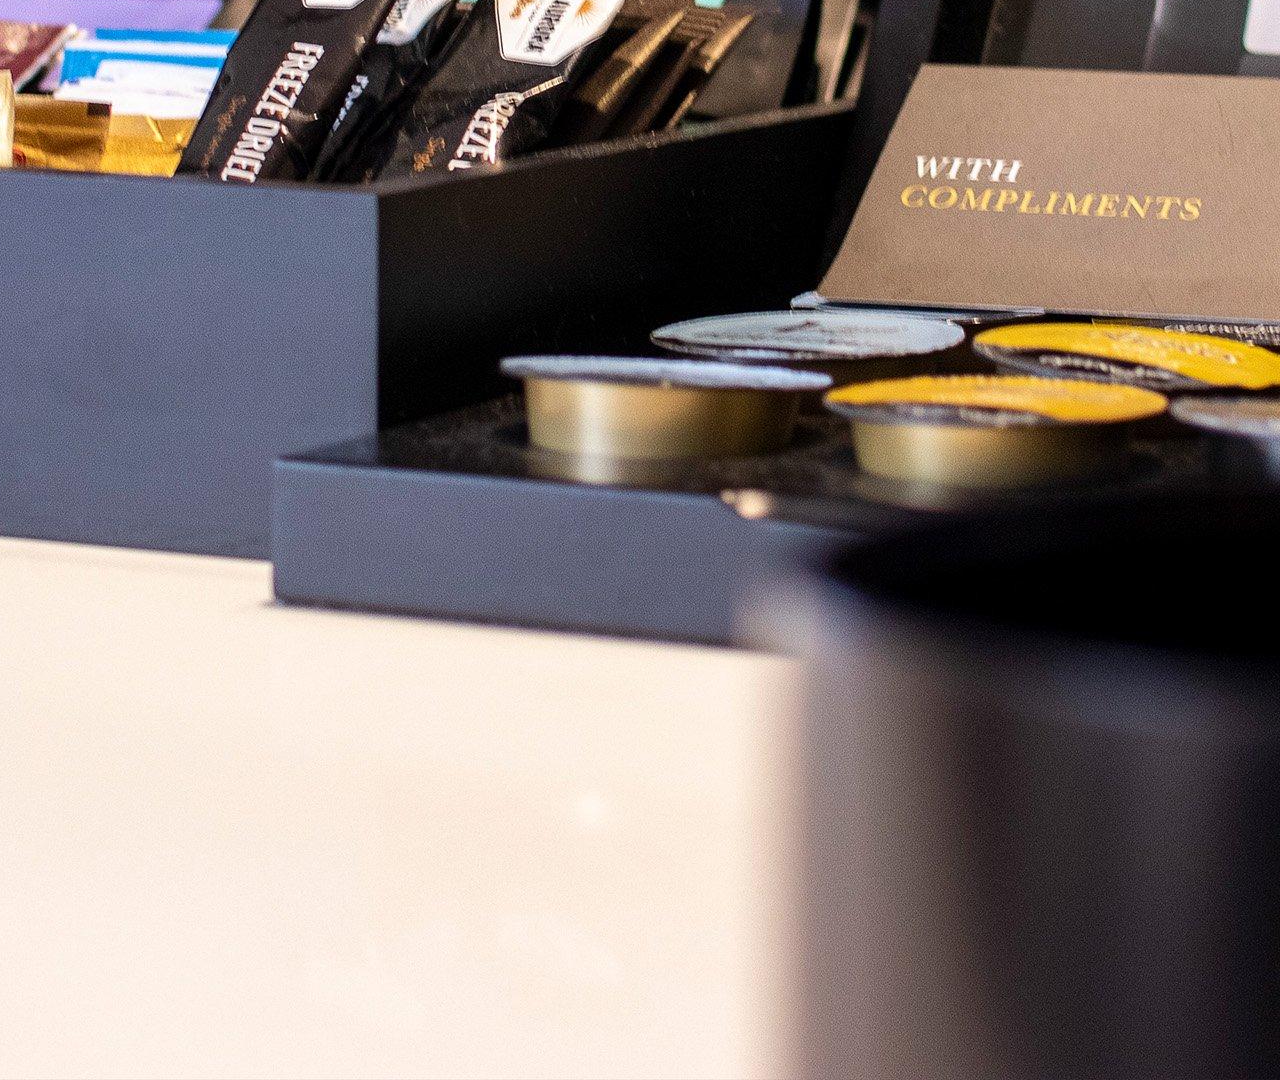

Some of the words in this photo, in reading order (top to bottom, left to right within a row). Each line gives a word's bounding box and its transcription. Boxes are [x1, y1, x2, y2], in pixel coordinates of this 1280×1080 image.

[255, 41, 324, 119] FREEZE
[916, 155, 1021, 182] WITH
[901, 186, 1202, 221] COMPLIMENTS
